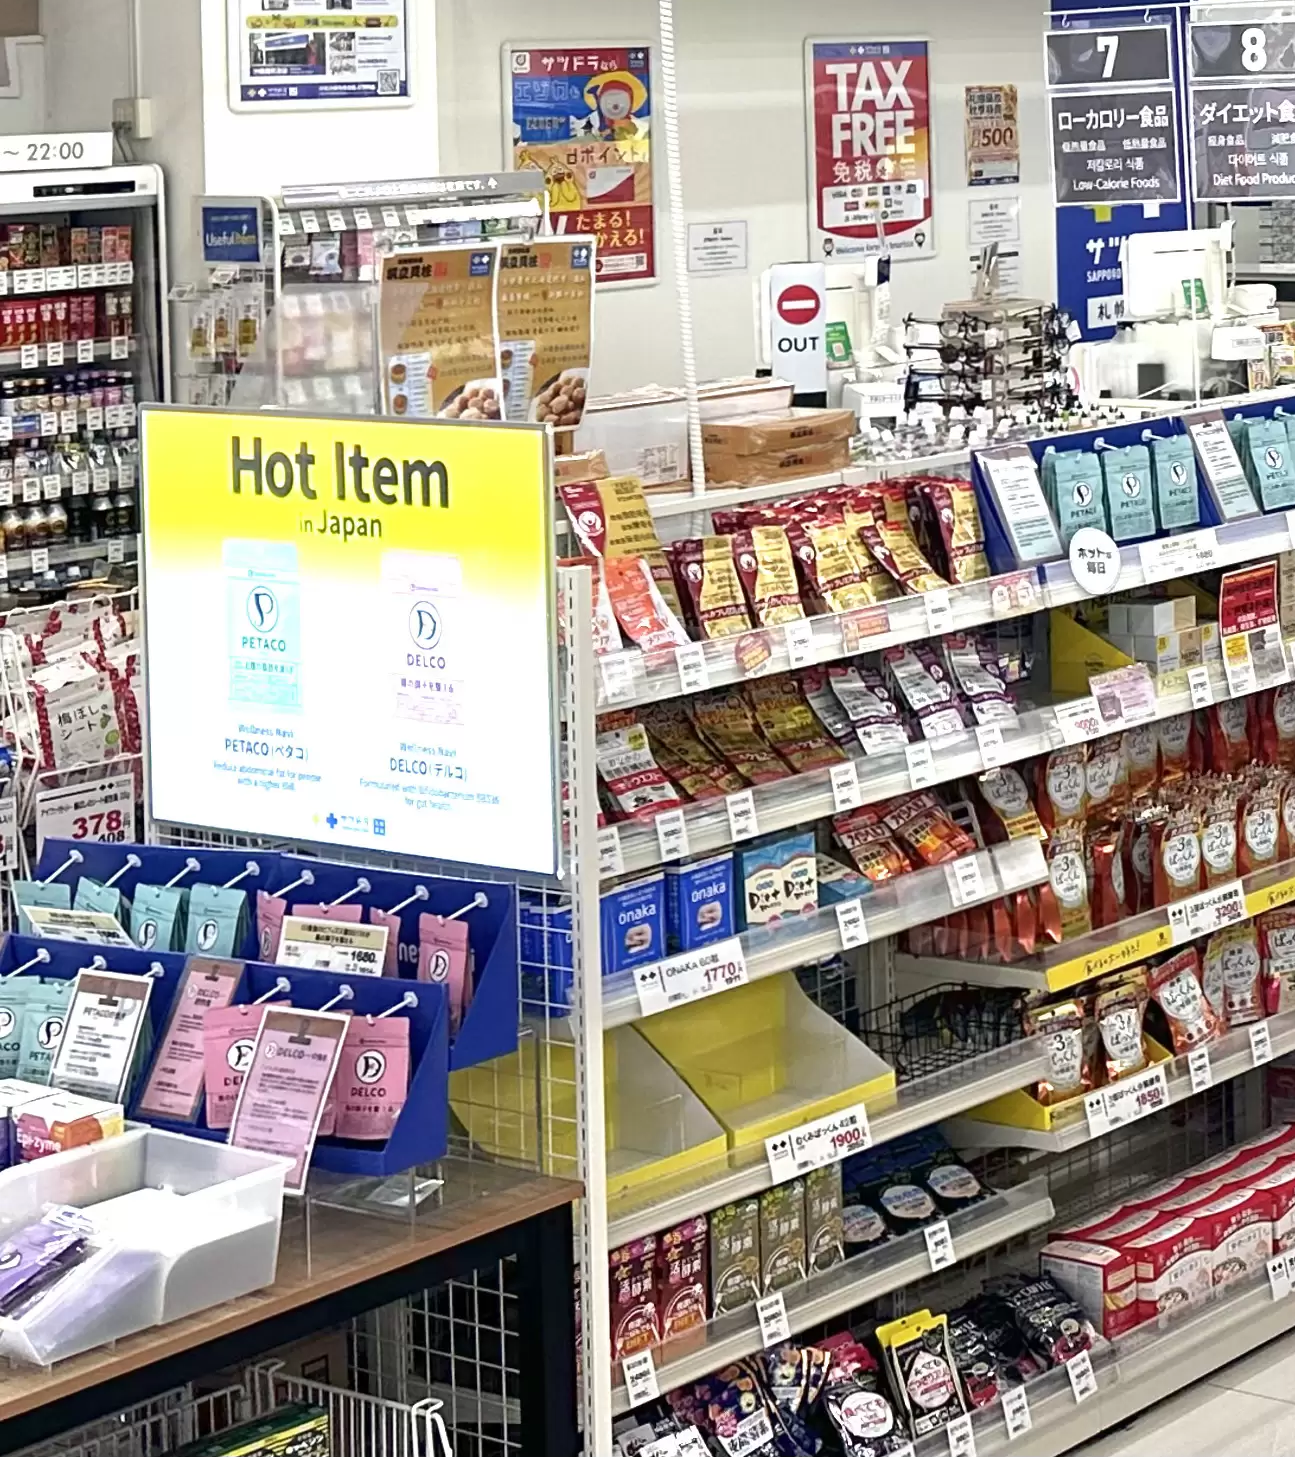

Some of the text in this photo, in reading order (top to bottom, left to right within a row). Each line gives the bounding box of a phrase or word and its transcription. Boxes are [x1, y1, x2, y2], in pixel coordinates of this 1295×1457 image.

[1096, 34, 1119, 78] 7
[1241, 26, 1267, 72] 8
[825, 60, 915, 113] TAX
[1057, 104, 1170, 132] ローカロリー食品
[832, 109, 916, 159] FREE
[981, 127, 1014, 148] 500
[26, 140, 85, 163] 22:00
[1072, 175, 1161, 193] Low-Calorie Foods
[1212, 172, 1233, 187] Diet
[1234, 172, 1261, 187] Food
[576, 211, 632, 229] たまる!
[594, 228, 645, 247] かえる!
[778, 335, 820, 354] OUT
[231, 433, 451, 510] Hot Item
[298, 509, 383, 542] in Japan
[242, 635, 287, 652] PETACO
[406, 652, 447, 670] DELCO
[57, 703, 110, 727] 梅ぼしの
[60, 719, 98, 741] シート
[72, 809, 122, 840] 378
[690, 881, 727, 903] onaka
[618, 903, 657, 926] onaka
[351, 950, 377, 964] 1680
[666, 961, 698, 978] ONAKA
[703, 962, 737, 984] 1770
[350, 1085, 387, 1099] DELCO
[829, 1129, 862, 1149] 1900
